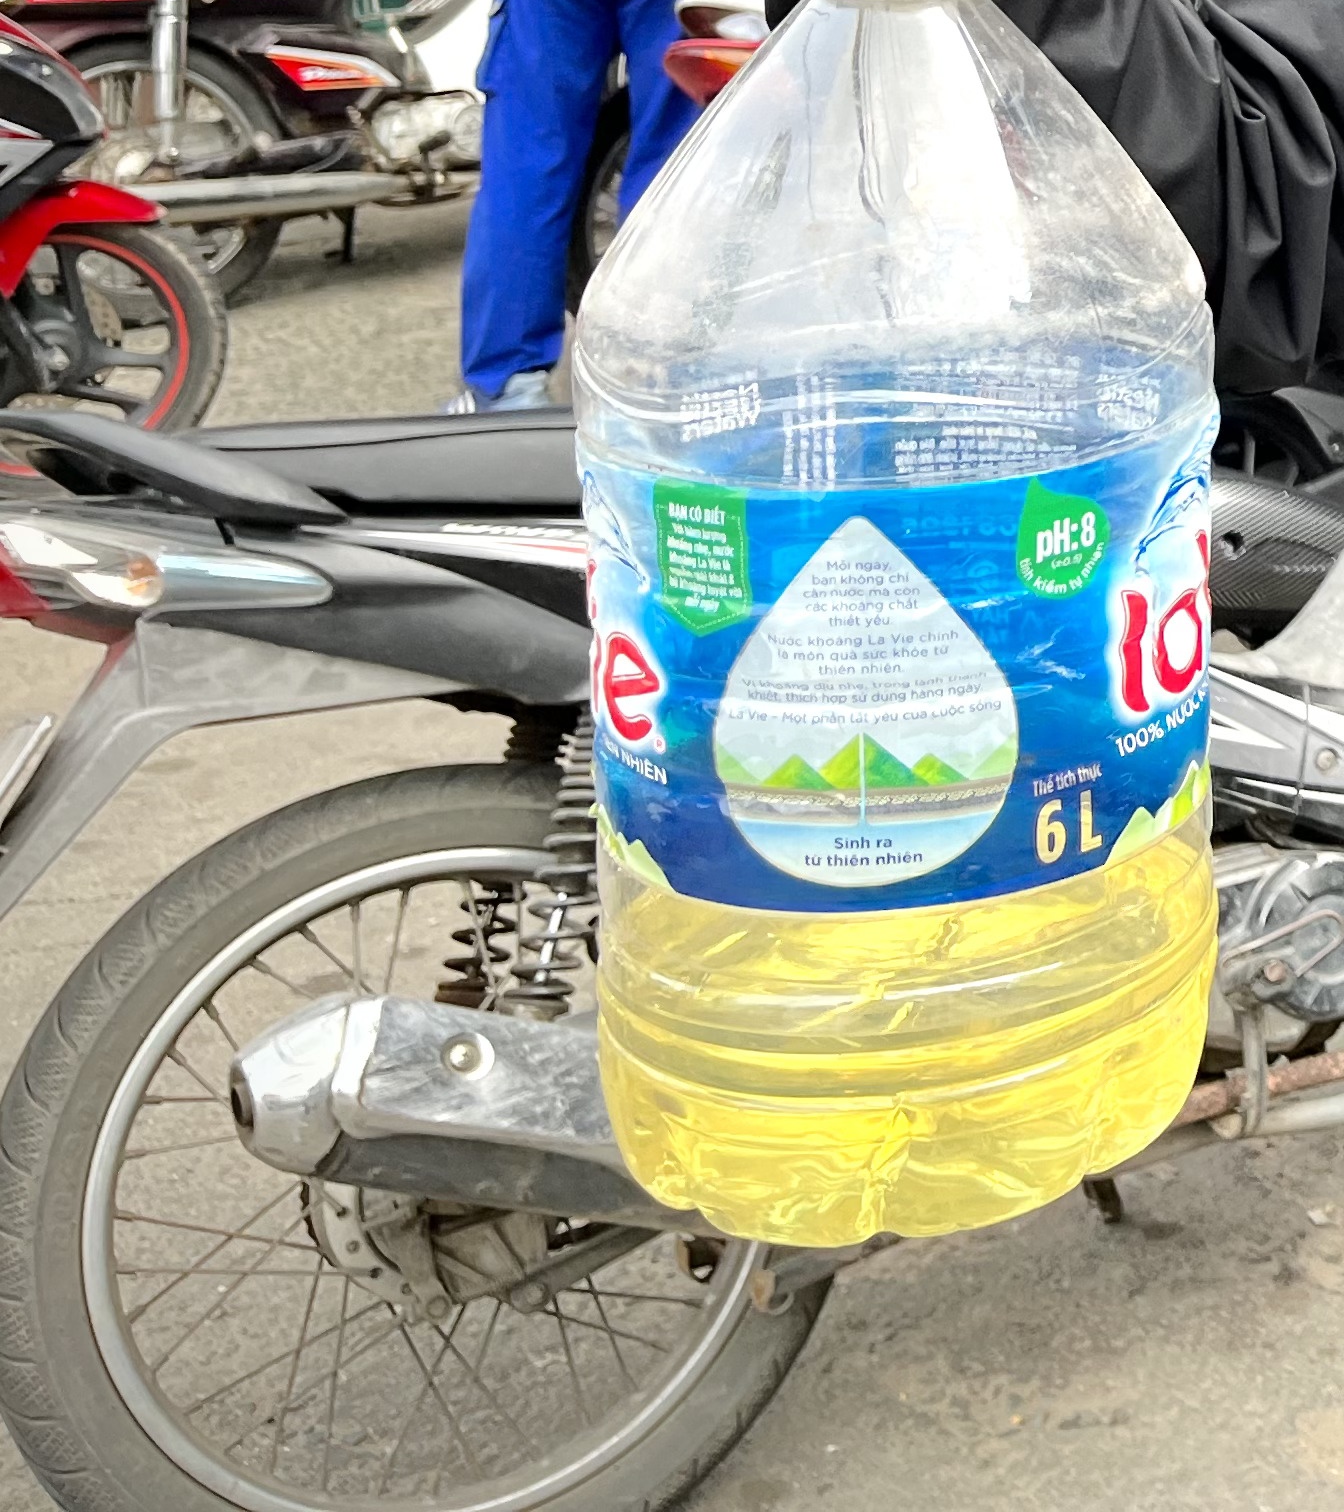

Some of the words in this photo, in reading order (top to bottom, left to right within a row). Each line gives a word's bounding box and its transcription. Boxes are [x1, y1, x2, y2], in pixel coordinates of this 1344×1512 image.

[1036, 511, 1096, 564] pH:8
[868, 635, 885, 645] La
[891, 633, 914, 644] Vie
[1115, 719, 1166, 757] 100%
[621, 744, 667, 786] NHIÊN
[1032, 772, 1055, 797] Thể
[1056, 768, 1077, 790] tích
[834, 836, 871, 850] Sinh
[876, 838, 893, 848] ra
[1035, 798, 1067, 864] 6
[1080, 789, 1103, 853] L
[826, 853, 870, 867] thiên
[875, 851, 923, 865] nhiên
